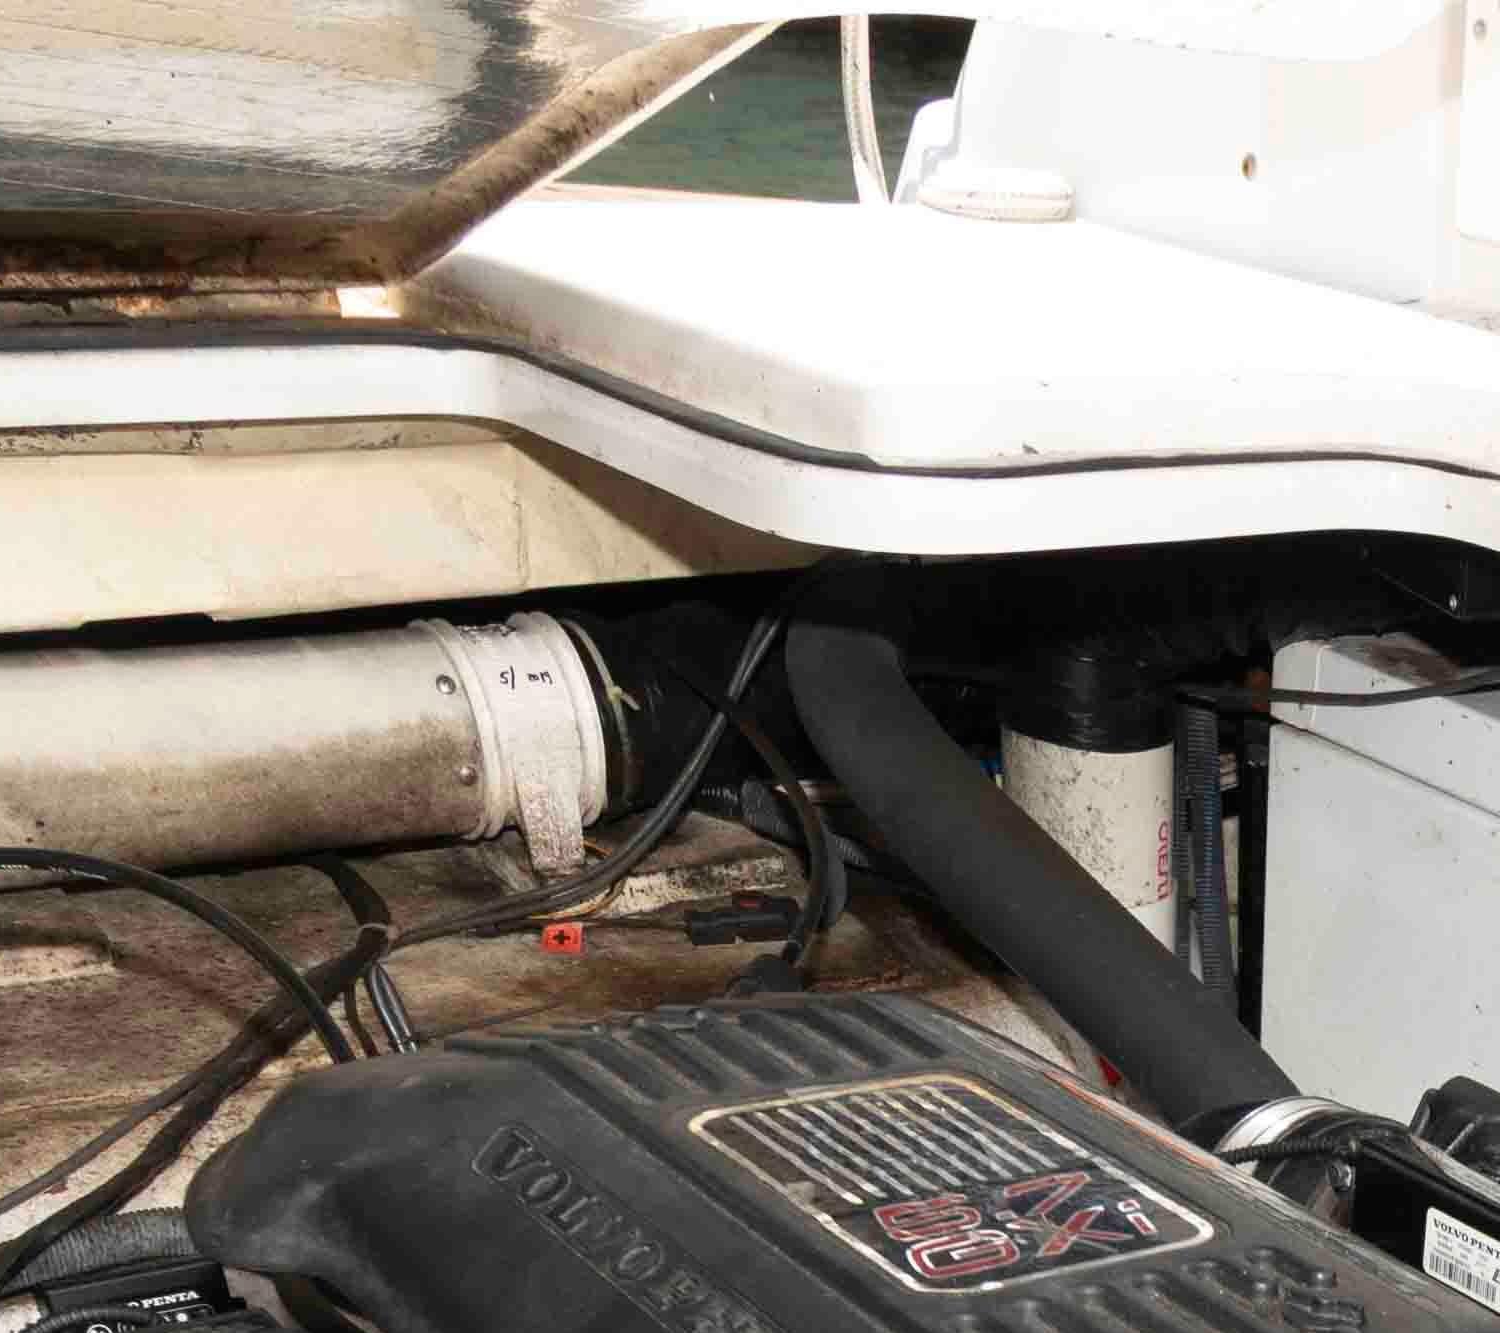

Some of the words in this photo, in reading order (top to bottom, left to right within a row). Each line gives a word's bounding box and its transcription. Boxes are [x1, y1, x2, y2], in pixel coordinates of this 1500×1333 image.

[484, 1130, 664, 1284] VOLVO
[1431, 1217, 1470, 1244] VOLVO
[141, 1291, 201, 1309] PENTA
